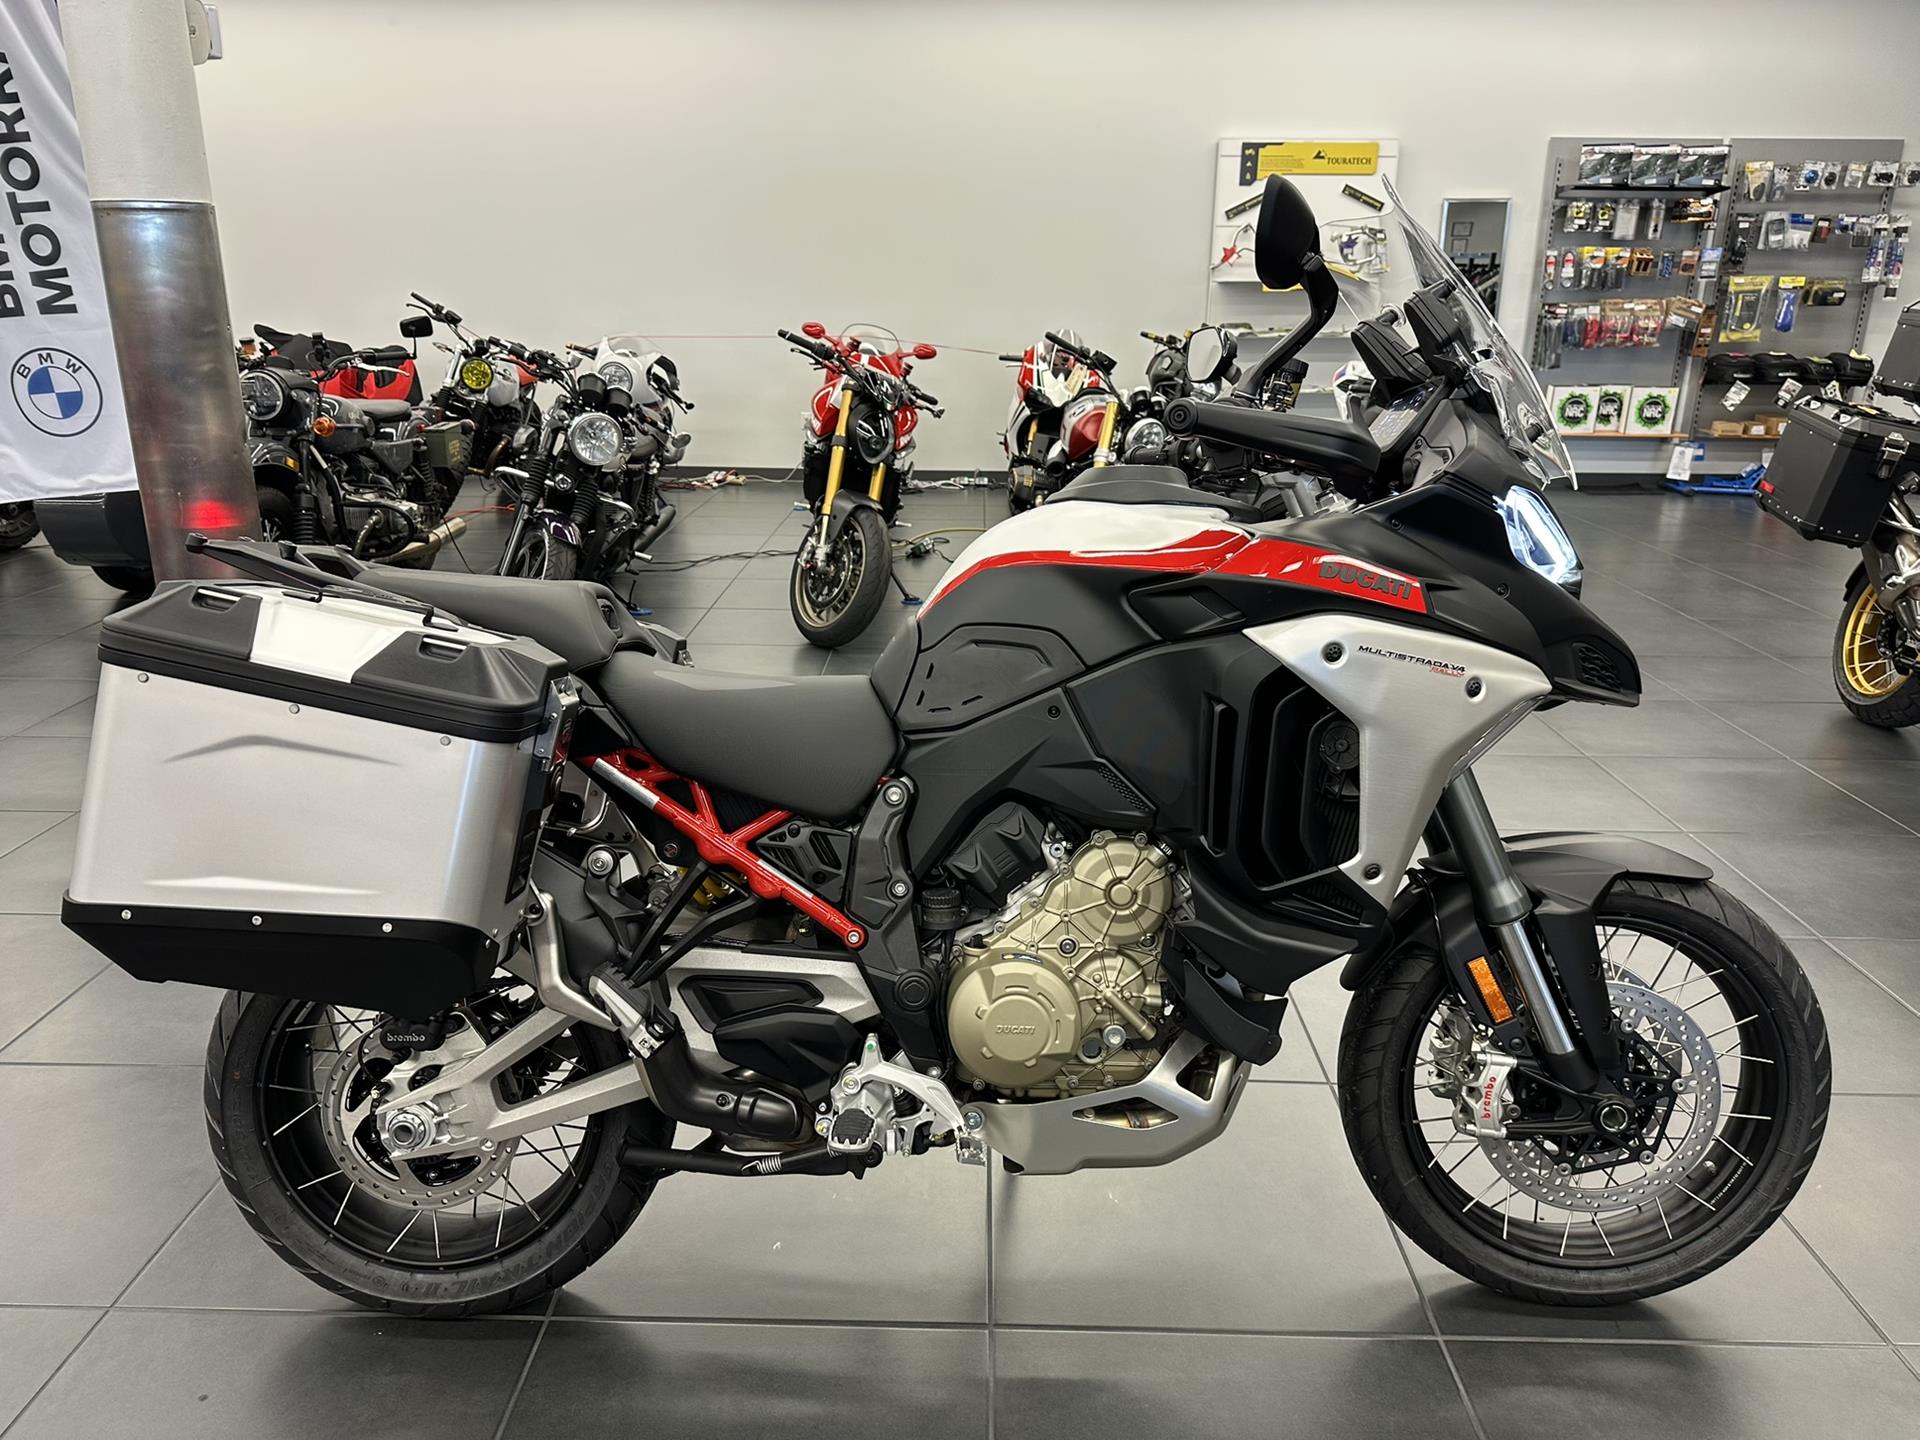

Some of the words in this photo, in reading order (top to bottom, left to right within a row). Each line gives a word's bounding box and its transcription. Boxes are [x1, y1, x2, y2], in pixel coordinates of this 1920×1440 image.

[1327, 157, 1372, 166] TOURATECH
[16, 352, 83, 380] BMW
[1319, 561, 1412, 600] DUCATI
[1430, 666, 1465, 678] RALLY
[995, 1024, 1036, 1035] DUCATI
[386, 1032, 426, 1042] brembo
[1481, 1076, 1497, 1120] brembo
